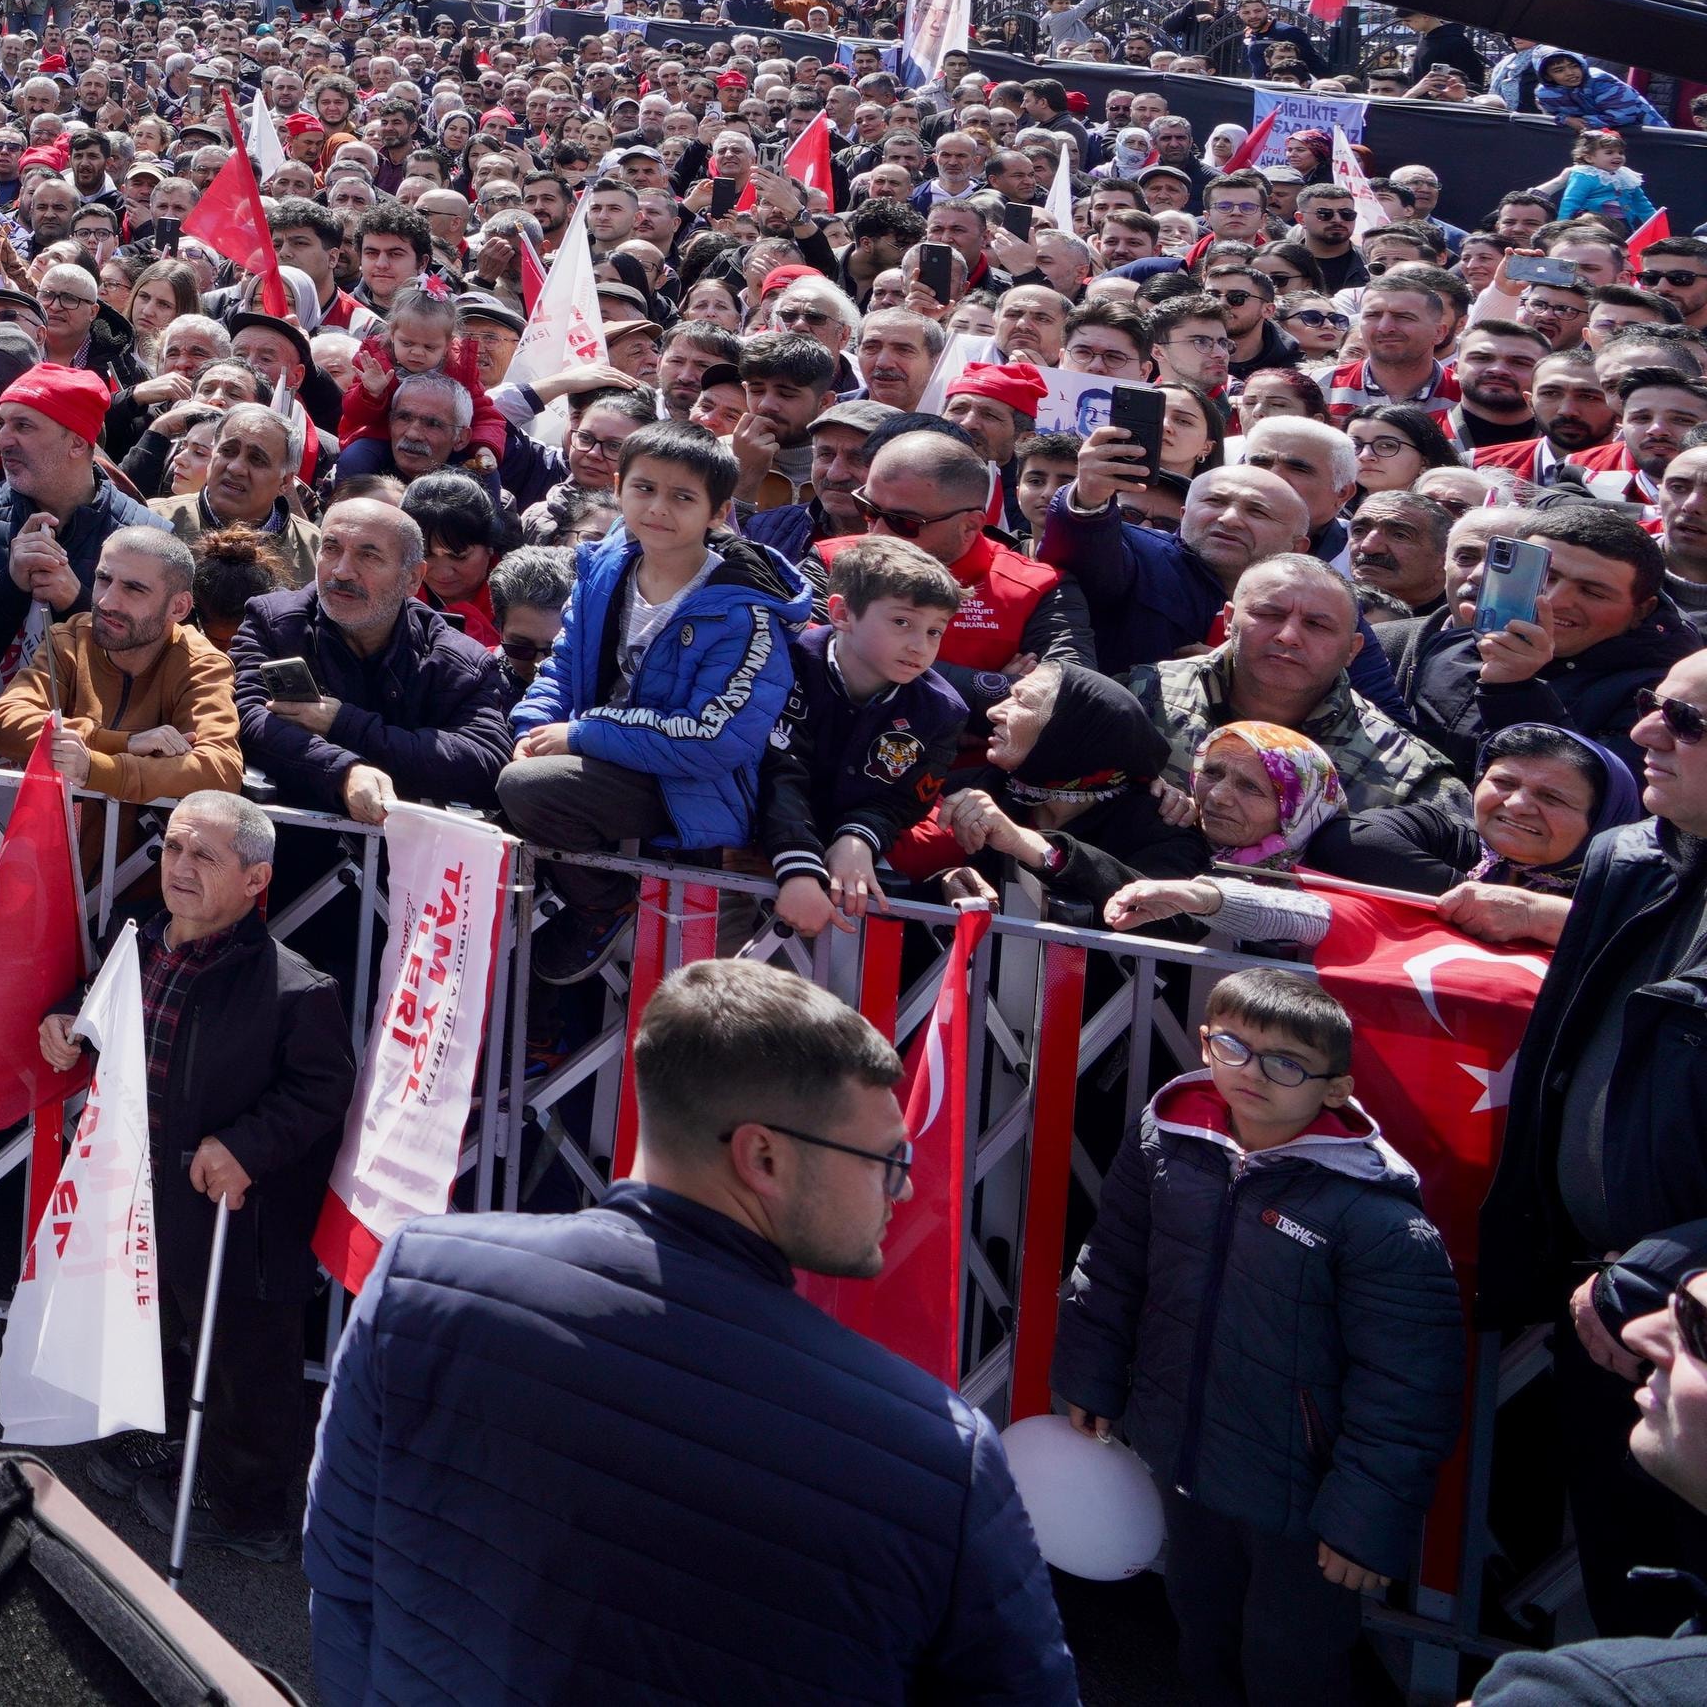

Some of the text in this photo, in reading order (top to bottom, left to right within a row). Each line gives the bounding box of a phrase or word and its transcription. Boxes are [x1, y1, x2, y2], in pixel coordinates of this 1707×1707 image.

[1275, 98, 1338, 122] BİRLİKTE
[960, 599, 984, 608] CHP
[965, 613, 983, 621] İLÇE
[428, 861, 464, 986] TAM
[391, 901, 438, 1051] İLERİ
[419, 874, 472, 1106] İSTANBUL'A HİZMETTE
[400, 1000, 439, 1104] YOL
[1275, 1219, 1315, 1248] LIMITED
